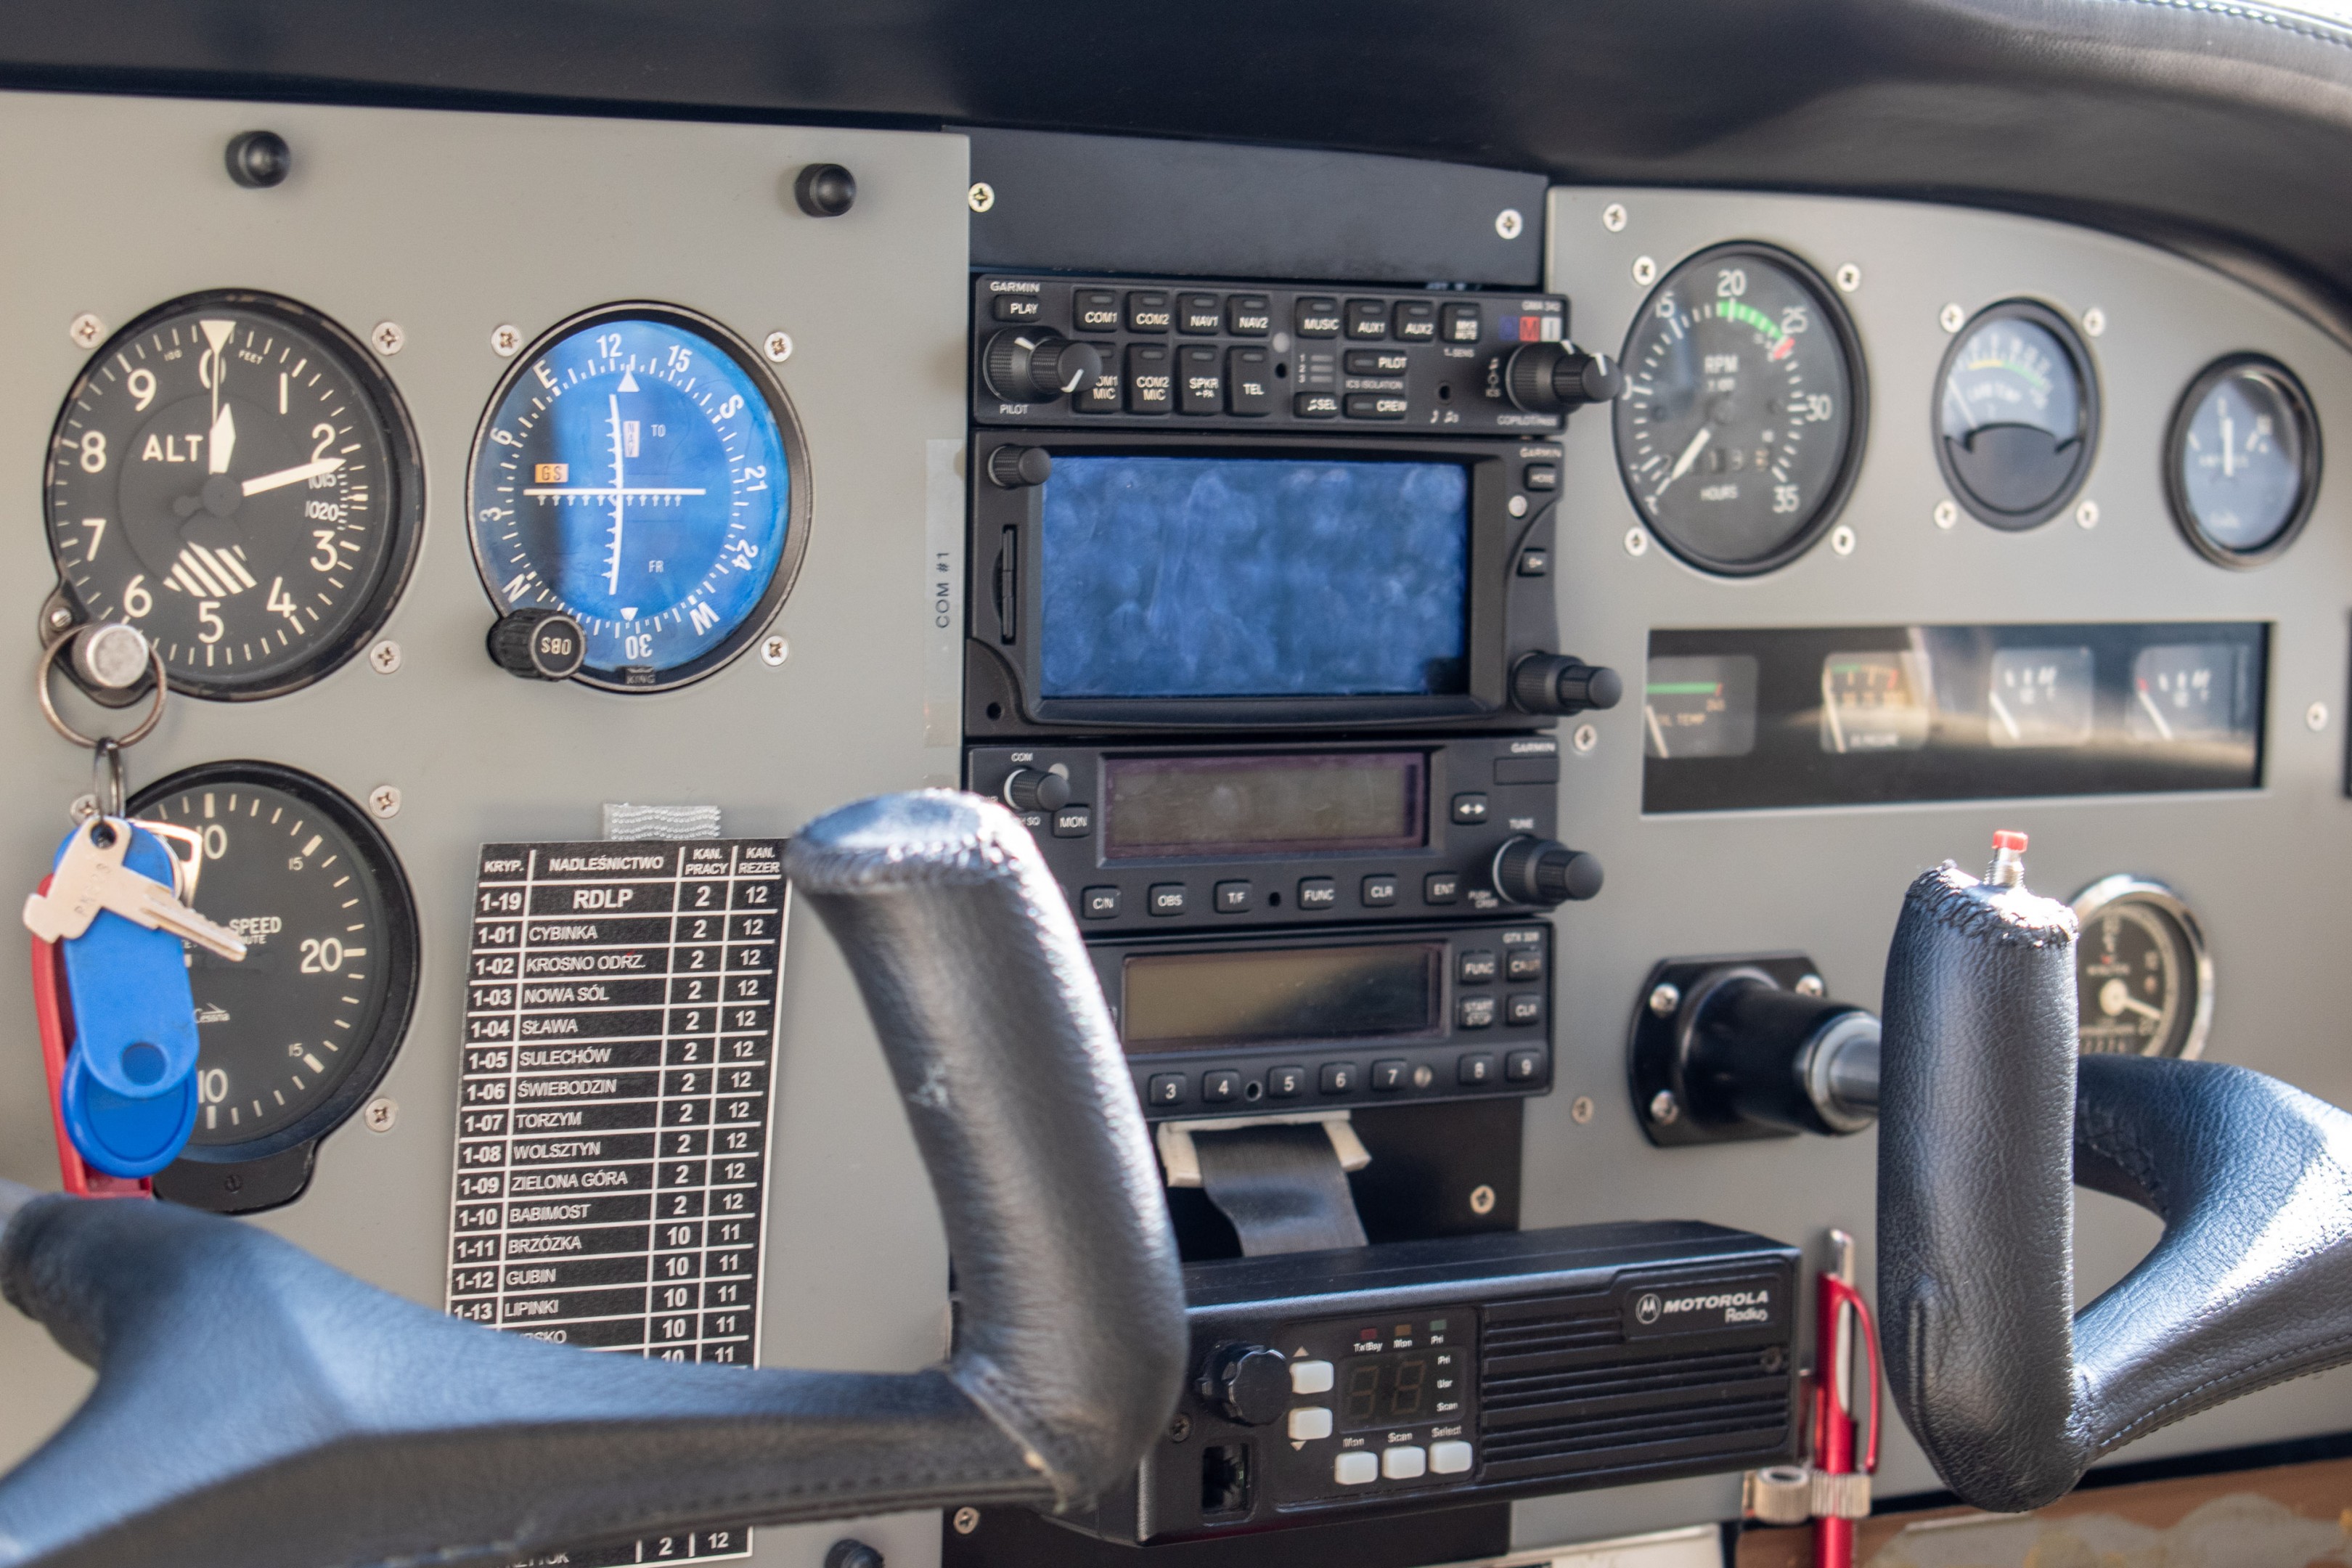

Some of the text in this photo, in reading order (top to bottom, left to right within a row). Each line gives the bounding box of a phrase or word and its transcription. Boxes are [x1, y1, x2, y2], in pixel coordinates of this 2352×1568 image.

[990, 282, 1040, 293] GARMIN
[1718, 269, 1746, 297] 20
[1010, 303, 1038, 315] PLAY
[1085, 311, 1116, 324] COM1
[1136, 313, 1169, 325] COM2
[1191, 315, 1219, 327] NAV1
[1239, 317, 1269, 328] NAV2
[1304, 318, 1339, 331] MUSIC
[1782, 307, 1808, 334] 25
[1358, 321, 1385, 334] AUX1
[1405, 322, 1434, 335] AUX2
[596, 333, 623, 358] 12
[239, 350, 264, 364] FEET
[669, 344, 693, 372] 15
[1379, 356, 1407, 369] PILOT
[1704, 355, 1738, 373] RPM
[199, 349, 226, 390] 0
[532, 359, 559, 389] E
[1136, 376, 1169, 388] COM2
[1189, 377, 1219, 390] SPKR
[1243, 383, 1264, 396] TEL
[128, 369, 158, 412] 9
[1093, 388, 1116, 400] MIC
[1143, 388, 1166, 401] MIC
[719, 395, 745, 420] S
[1000, 404, 1029, 415] PILOT
[1317, 399, 1337, 411] SEL
[1376, 400, 1407, 412] CREW
[1805, 395, 1832, 421] 30
[650, 425, 666, 437] TO
[81, 430, 106, 473] 8
[142, 434, 203, 462] ALT
[311, 424, 335, 463] 2
[1520, 447, 1561, 458] GARMIN
[541, 465, 563, 481] GS
[745, 465, 767, 491] 21
[1700, 486, 1738, 501] HOURS
[1773, 485, 1800, 513] 35
[305, 501, 341, 522] 1020
[478, 507, 502, 521] 3
[83, 518, 107, 561] 7
[311, 531, 338, 571] 3
[731, 539, 759, 571] 24
[648, 560, 664, 573] FR
[123, 574, 152, 617] 6
[502, 573, 532, 603] N
[936, 552, 950, 629] COM #1
[267, 576, 297, 618] 4
[199, 602, 224, 643] 5
[690, 601, 720, 636] W
[541, 636, 572, 656] OBS
[625, 633, 653, 659] 30
[1511, 742, 1556, 753] GARMIN
[1011, 753, 1033, 761] COM
[1060, 817, 1087, 828] MON
[1509, 818, 1535, 829] TUNE
[693, 848, 722, 860] KAN.
[746, 847, 775, 858] KAN.
[288, 857, 303, 871] 15
[484, 860, 524, 873] KRYP.
[549, 855, 664, 872] NADLEŚNICTWO
[685, 862, 727, 875] PRACY
[738, 862, 780, 873] REZER
[1228, 892, 1246, 904] T/F
[1304, 889, 1334, 902] FUNC
[1371, 886, 1393, 898] CLR
[1434, 884, 1455, 896] ENT
[480, 886, 768, 912] 1-19 RDLP 2 12
[1093, 898, 1114, 910] C/N
[1157, 895, 1183, 907] OBS
[229, 916, 282, 935] SPEED
[478, 918, 764, 943] 1-01 CYBINKA 2 12
[301, 938, 343, 973] 20
[475, 954, 646, 975] 1-02 KROSNO ODRZ.
[1465, 963, 1495, 974] FUNC
[473, 979, 759, 1006] 1-03 NOWA SÓL 2 12
[1516, 1003, 1536, 1016] CLR
[470, 1018, 578, 1038] 1-04 SŁAWA
[288, 1043, 303, 1058] 15
[469, 1047, 611, 1069] 1-05 SULECHÓW
[1474, 1063, 1484, 1078] 8
[1522, 1060, 1531, 1075] 9
[1283, 1076, 1294, 1092] 5
[1336, 1072, 1346, 1087] 6
[1388, 1070, 1397, 1085] 7
[198, 1069, 229, 1103] 10
[467, 1078, 617, 1101] 1-06 ŚWIEBODZIN
[1166, 1083, 1177, 1100] 3
[1217, 1079, 1229, 1095] 4
[465, 1101, 750, 1132] 1-07 TORZYM 2 12
[463, 1142, 601, 1164] 1-08 WOLSZTYN
[460, 1170, 628, 1195] 1-09 ZIELONA GÓRA
[459, 1193, 743, 1227] 1-10 BABIMOST 2 12
[457, 1224, 740, 1259] 1-11 BRZÓZKA 10 11
[455, 1269, 556, 1289] 1-12 GUBIN
[454, 1285, 737, 1320] 1-13 LIPINKI 10 11
[1663, 1291, 1769, 1314] MOTOROLA
[662, 1316, 735, 1339] 10 11
[1393, 1339, 1412, 1349] Mon
[714, 1346, 734, 1363] 11
[1437, 1401, 1458, 1411] Scan
[1388, 1432, 1413, 1442] Scan
[1432, 1426, 1461, 1438] Select
[1343, 1437, 1365, 1447] Mon
[658, 1532, 729, 1556] 2 12
